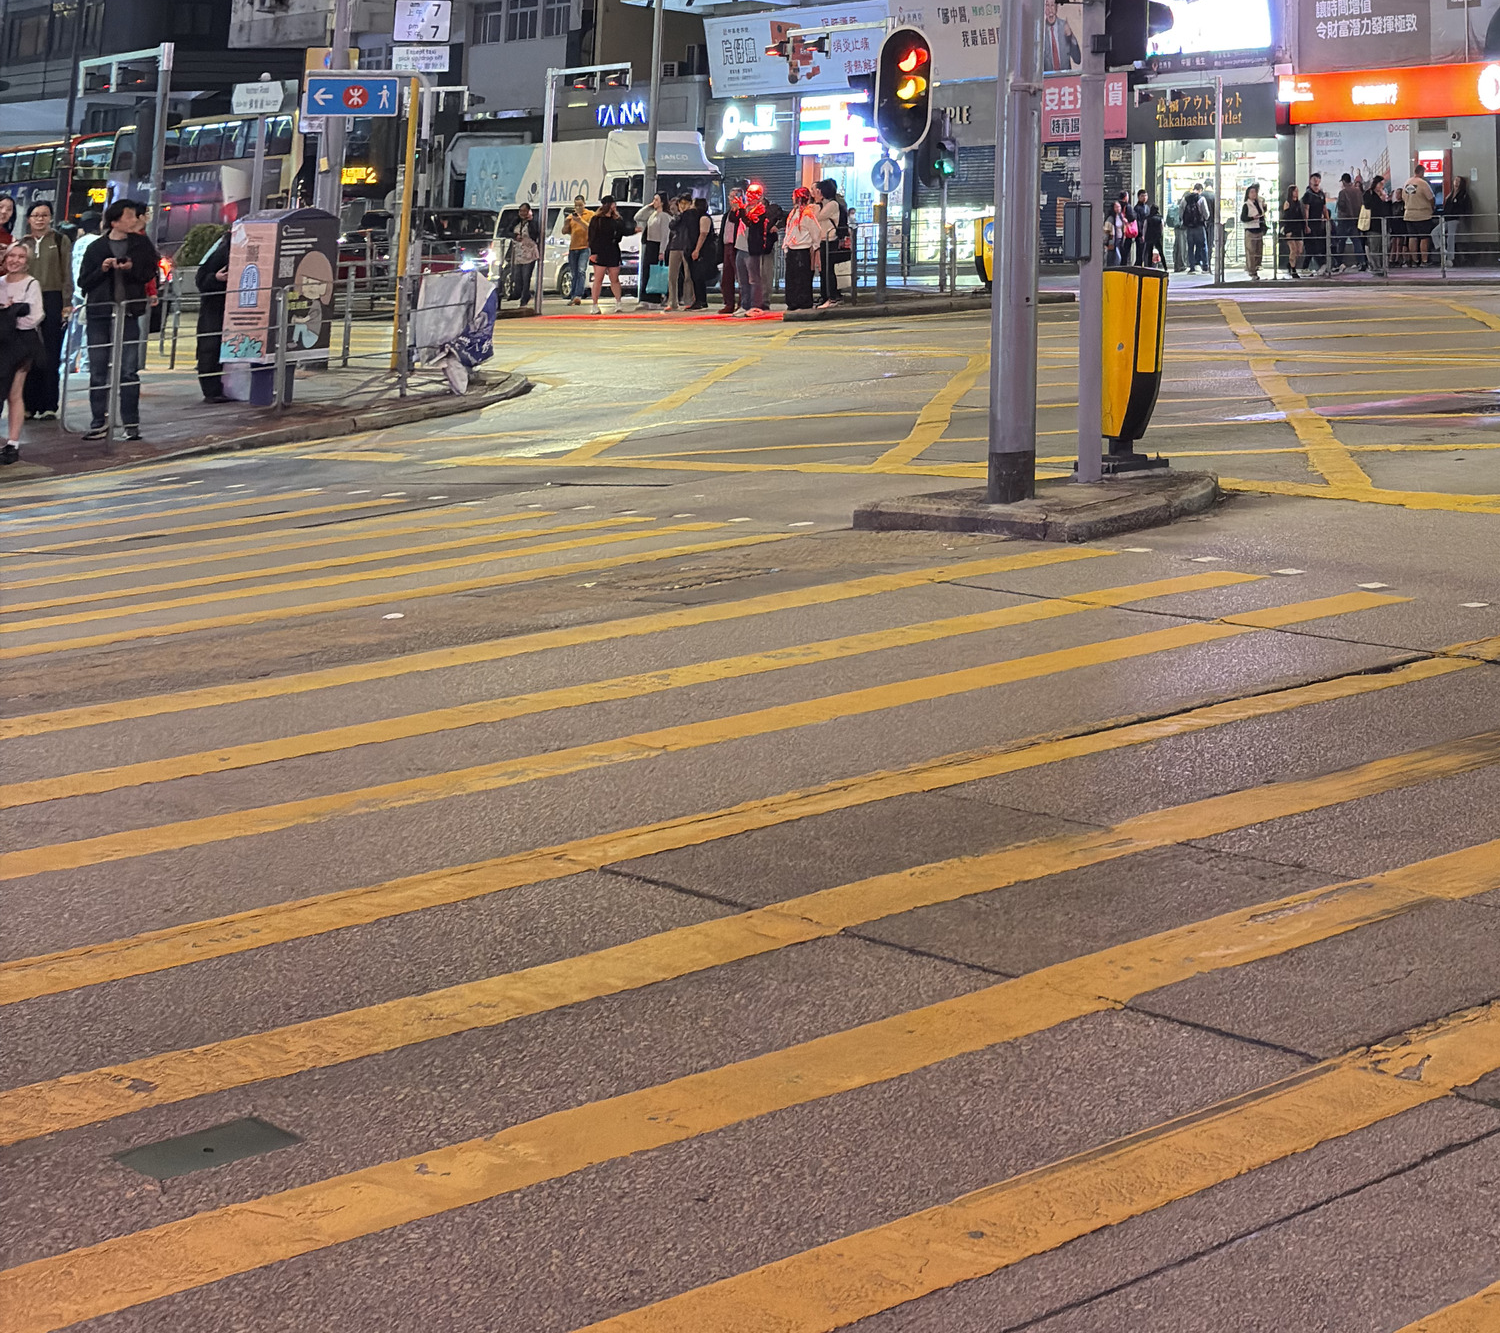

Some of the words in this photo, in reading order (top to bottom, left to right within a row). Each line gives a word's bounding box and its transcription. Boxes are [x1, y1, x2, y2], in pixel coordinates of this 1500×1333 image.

[432, 4, 441, 17] 7
[431, 26, 440, 39] 7
[1316, 14, 1418, 39] 令財富潛力發揮極致
[1157, 113, 1207, 128] Takahashi
